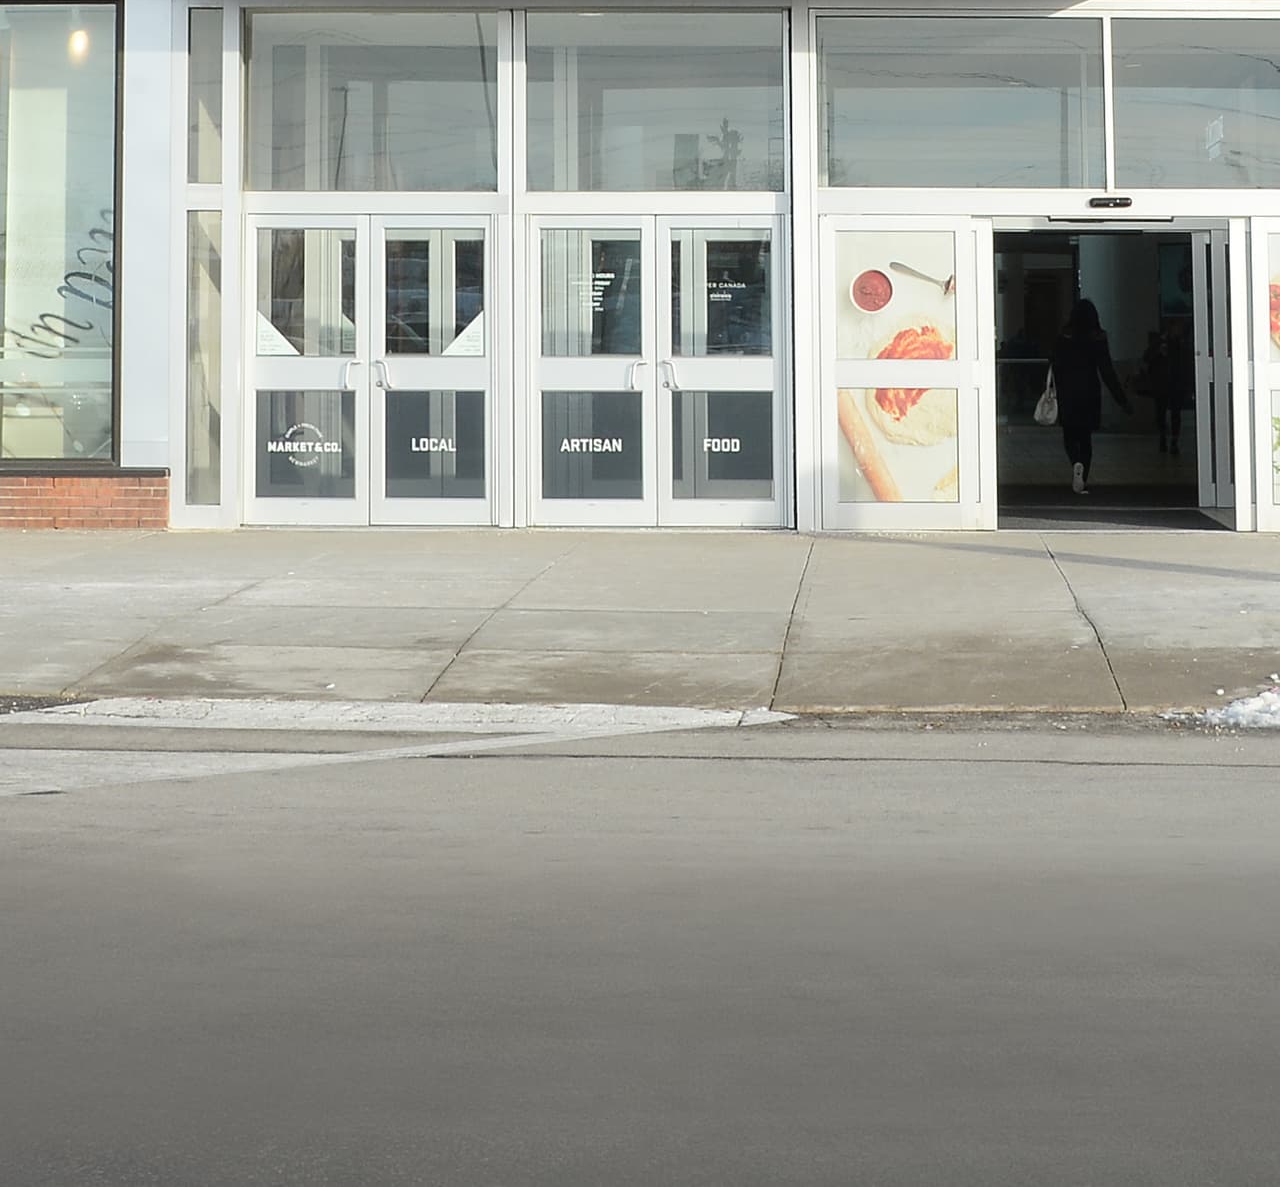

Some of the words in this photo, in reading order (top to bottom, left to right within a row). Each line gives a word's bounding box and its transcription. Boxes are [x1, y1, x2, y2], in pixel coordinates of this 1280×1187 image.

[411, 437, 457, 452] LOCAL
[560, 438, 623, 453] ARTISAN
[703, 438, 741, 453] FOOD
